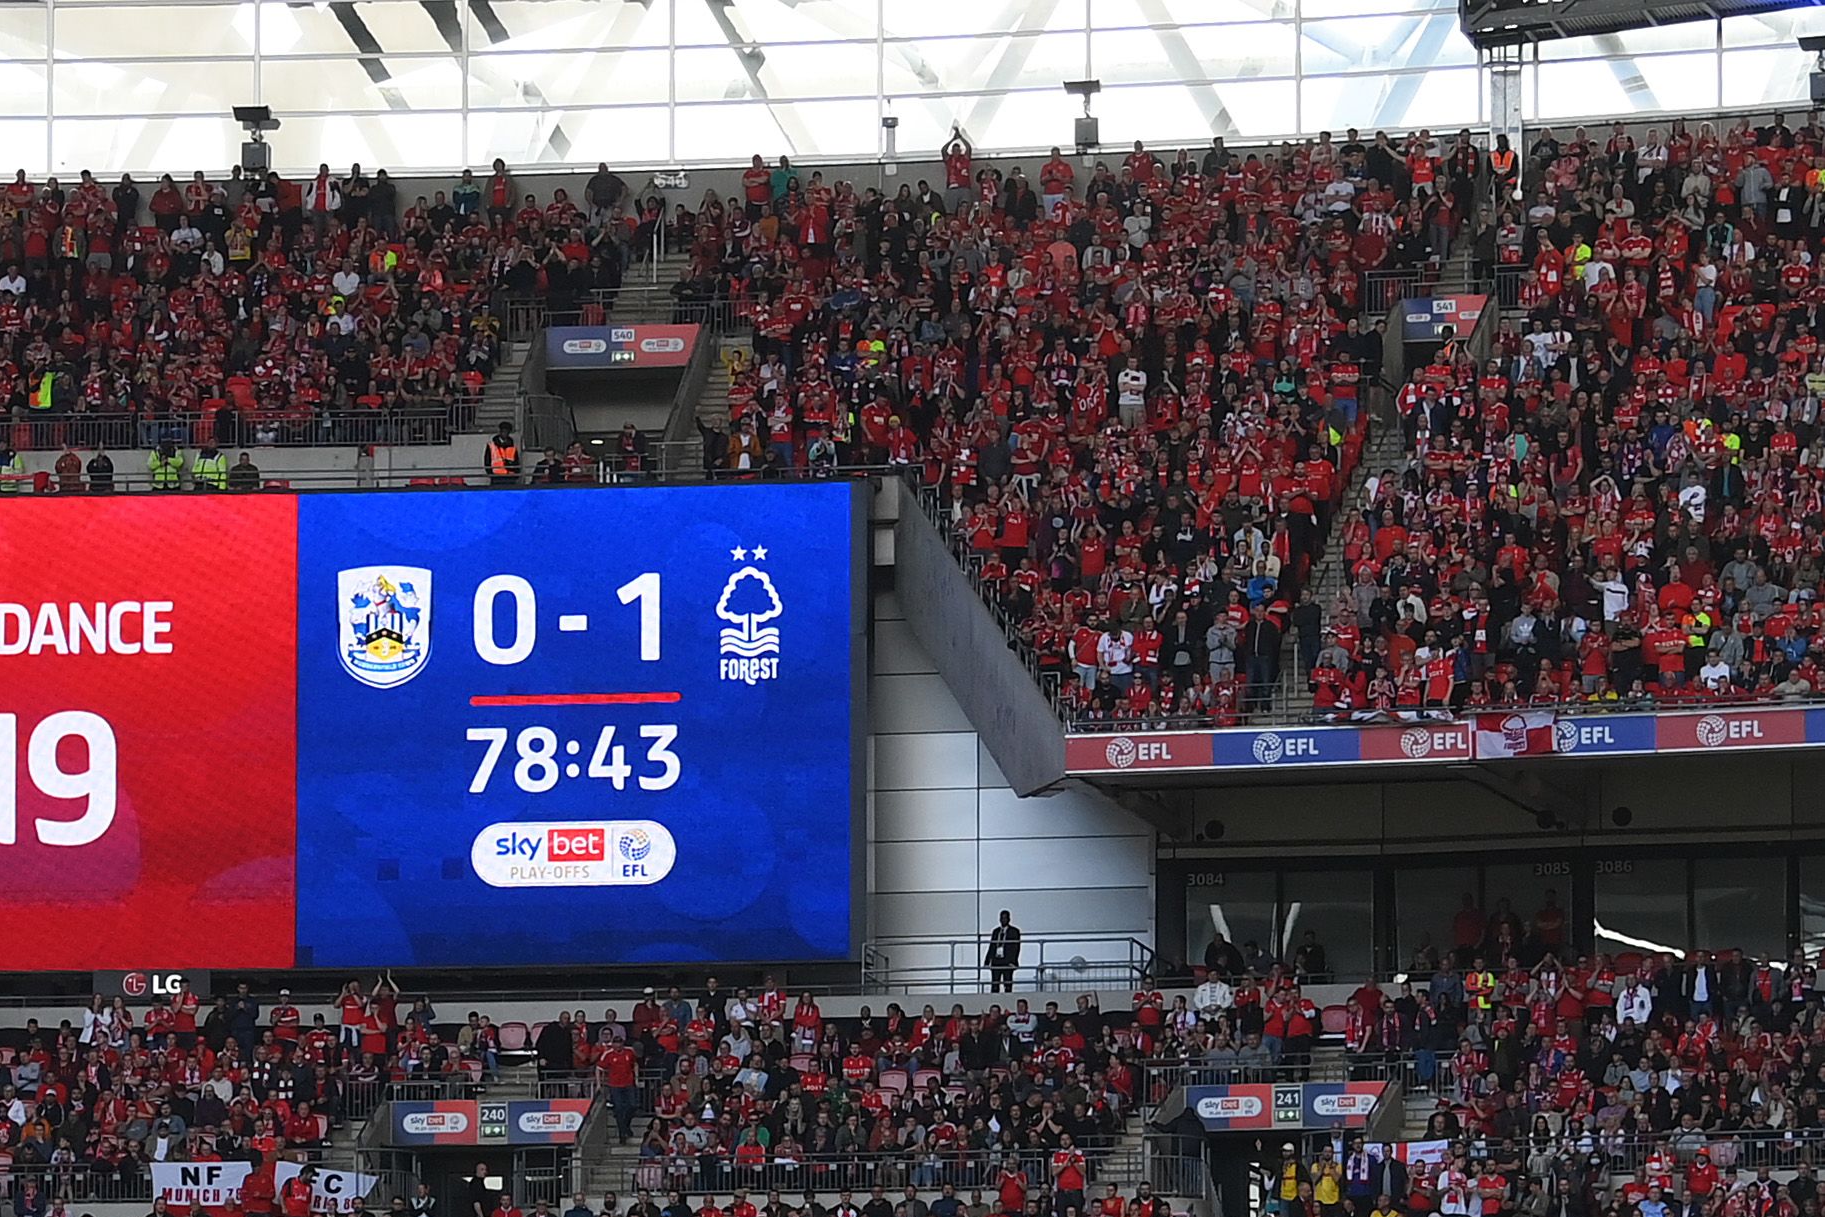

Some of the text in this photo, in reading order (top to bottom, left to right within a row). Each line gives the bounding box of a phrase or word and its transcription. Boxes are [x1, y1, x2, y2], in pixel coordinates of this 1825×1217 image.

[1436, 302, 1453, 311] 541
[613, 330, 632, 340] 540
[473, 572, 661, 665] 0 - 1
[1580, 726, 1614, 744] EFL
[1728, 720, 1763, 738] EFL
[1284, 739, 1319, 756] EFL
[1433, 732, 1467, 750] EFL
[466, 725, 681, 793] 78:43
[1138, 742, 1172, 761] EFL
[496, 830, 599, 860] sky bet
[510, 865, 590, 880] PLAY-OFFS
[623, 864, 648, 878] EFL
[152, 974, 182, 994] LG
[1204, 1099, 1239, 1110] sky bet
[1276, 1092, 1300, 1105] 241
[1320, 1096, 1356, 1107] sky bet
[410, 1115, 444, 1125] sky bet
[482, 1109, 505, 1121] 240
[526, 1114, 560, 1124] sky bet
[162, 1187, 220, 1202] MUNICH
